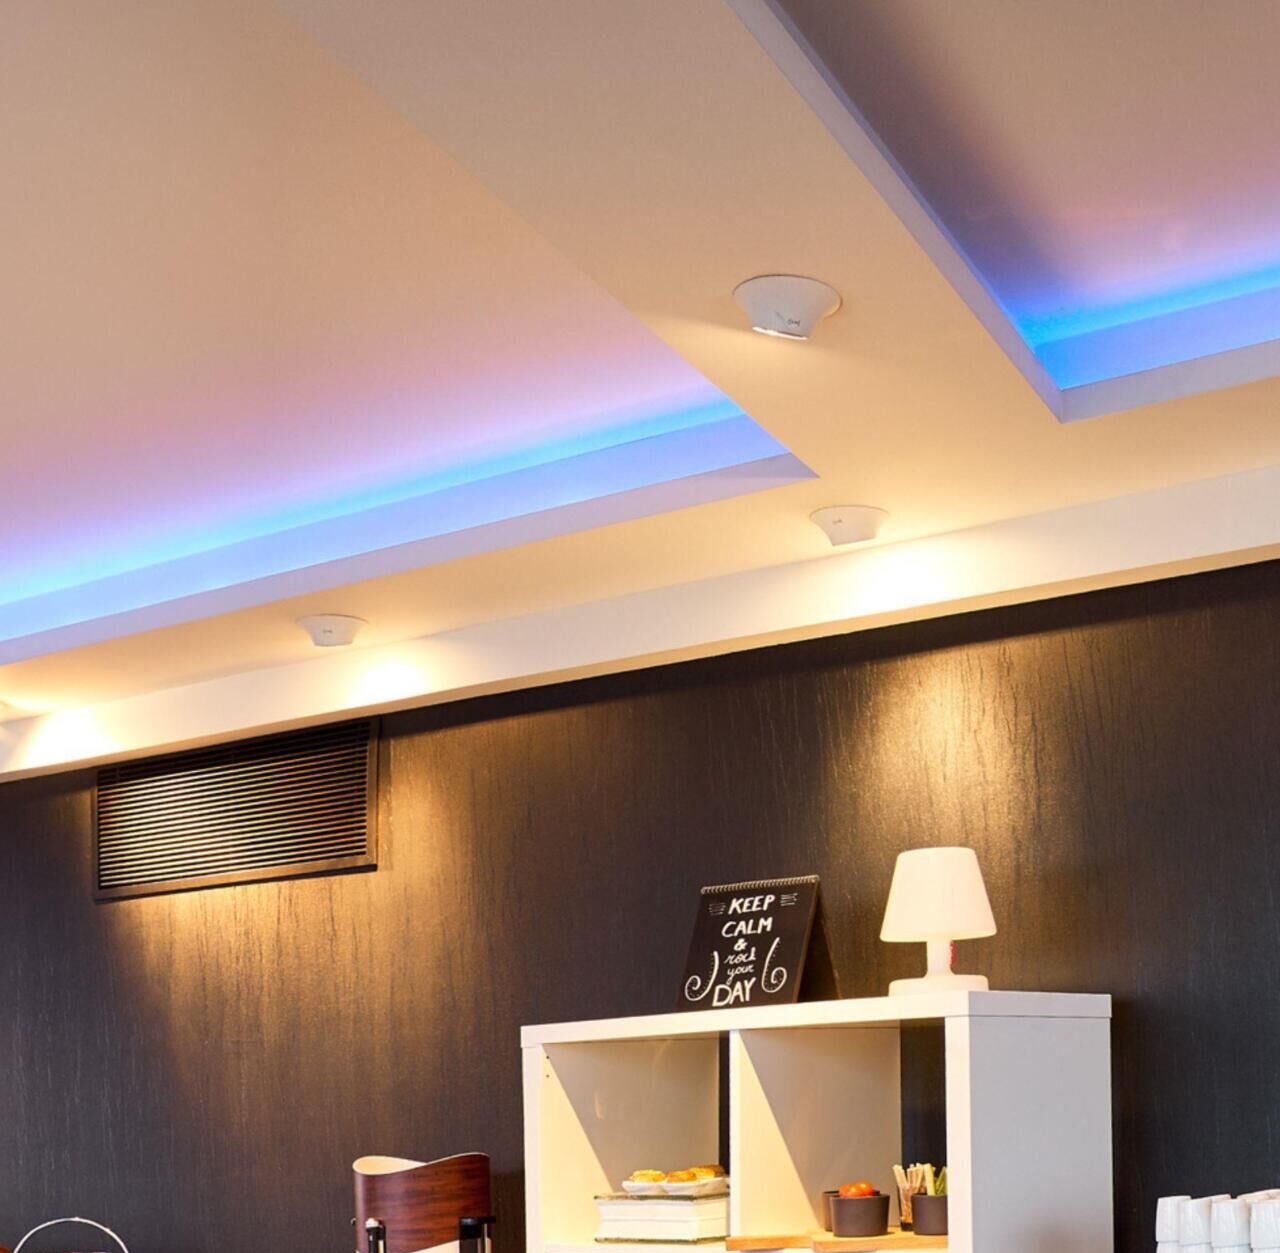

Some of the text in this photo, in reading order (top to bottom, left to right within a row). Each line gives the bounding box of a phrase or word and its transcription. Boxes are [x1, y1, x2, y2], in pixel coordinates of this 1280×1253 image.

[728, 894, 775, 915] KEEP
[721, 917, 773, 937] CALM
[733, 938, 748, 951] &
[726, 964, 754, 985] your
[712, 977, 756, 1007] DAY
